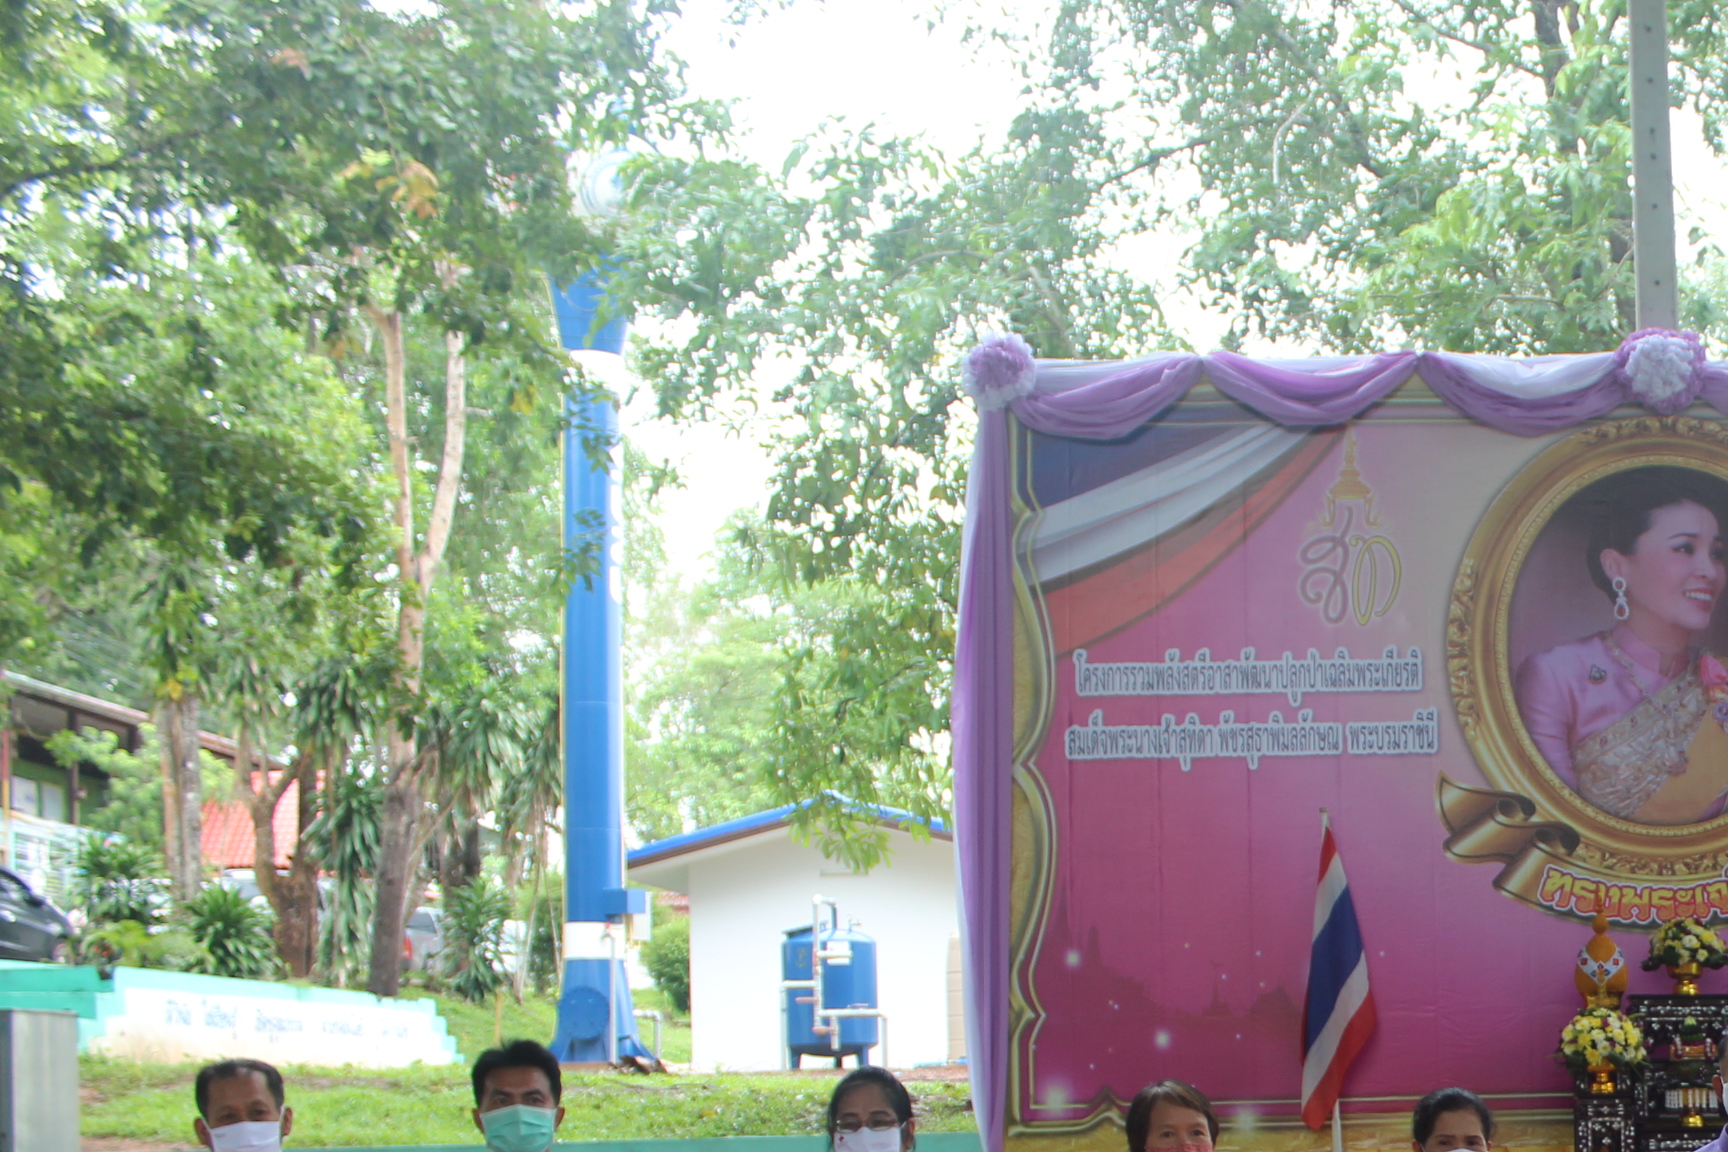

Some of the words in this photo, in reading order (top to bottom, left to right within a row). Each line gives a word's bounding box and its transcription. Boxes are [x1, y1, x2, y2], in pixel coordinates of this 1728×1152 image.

[1075, 648, 1420, 703] โครงการรวมพลังสตรีอาสาพัฒนาปลูกป่าเฉลิมพระเกียรติ
[1067, 713, 1214, 768] สมเด็จพระนางเจ้าสุทิดา
[1218, 713, 1340, 767] พัชรสุธาพิมลลักษณ
[1348, 710, 1435, 751] พระบรมราชินี
